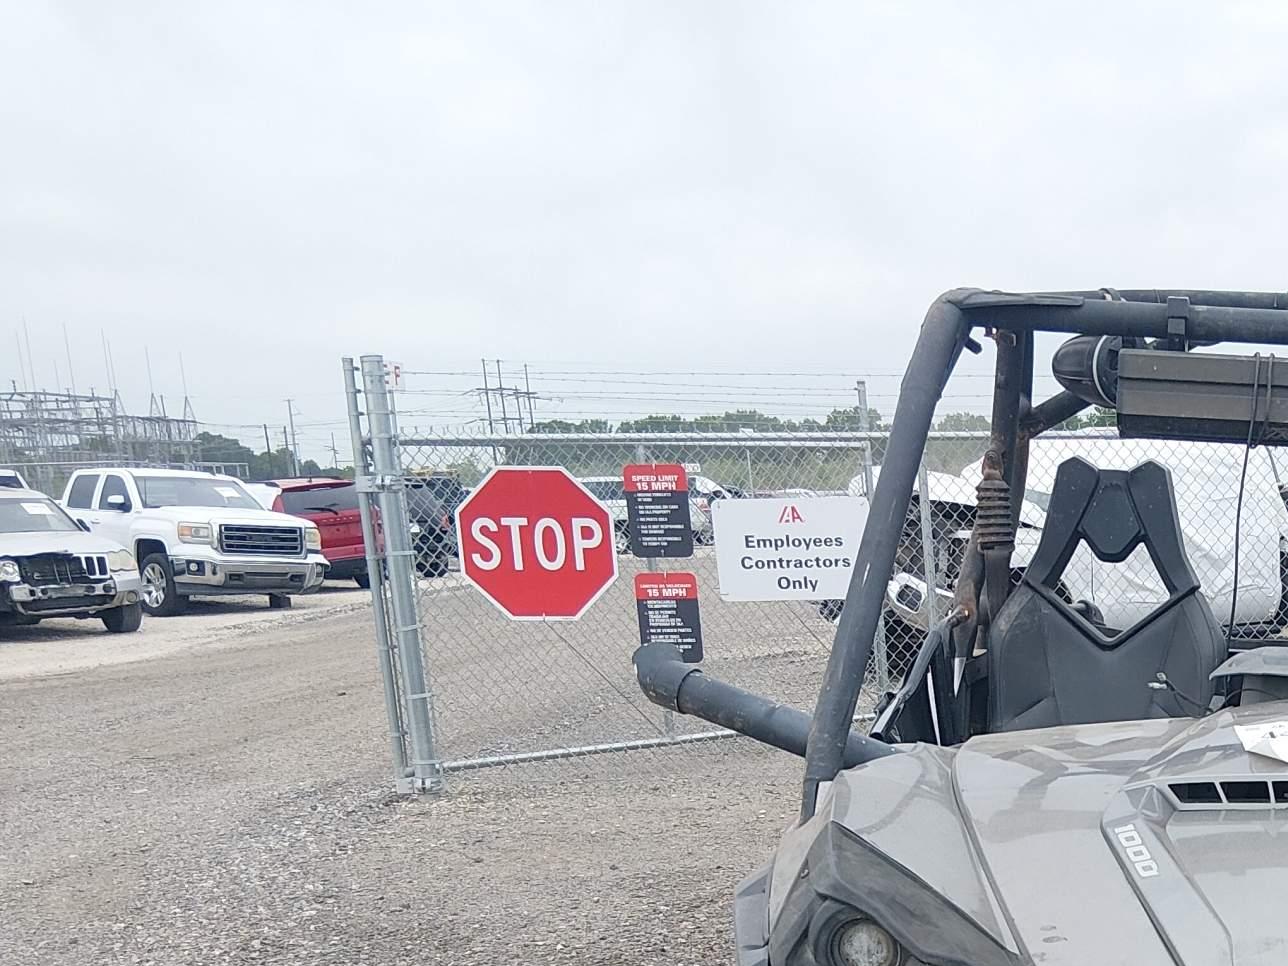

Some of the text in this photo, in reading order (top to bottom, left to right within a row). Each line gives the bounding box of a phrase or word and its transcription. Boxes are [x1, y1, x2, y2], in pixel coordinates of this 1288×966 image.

[637, 482, 676, 491] 15 MPH
[471, 517, 603, 571] STOP
[744, 535, 843, 551] Employees
[740, 556, 851, 570] Contractors
[777, 576, 818, 592] Only
[647, 588, 687, 597] 15 MPH
[1114, 823, 1160, 878] 1000
